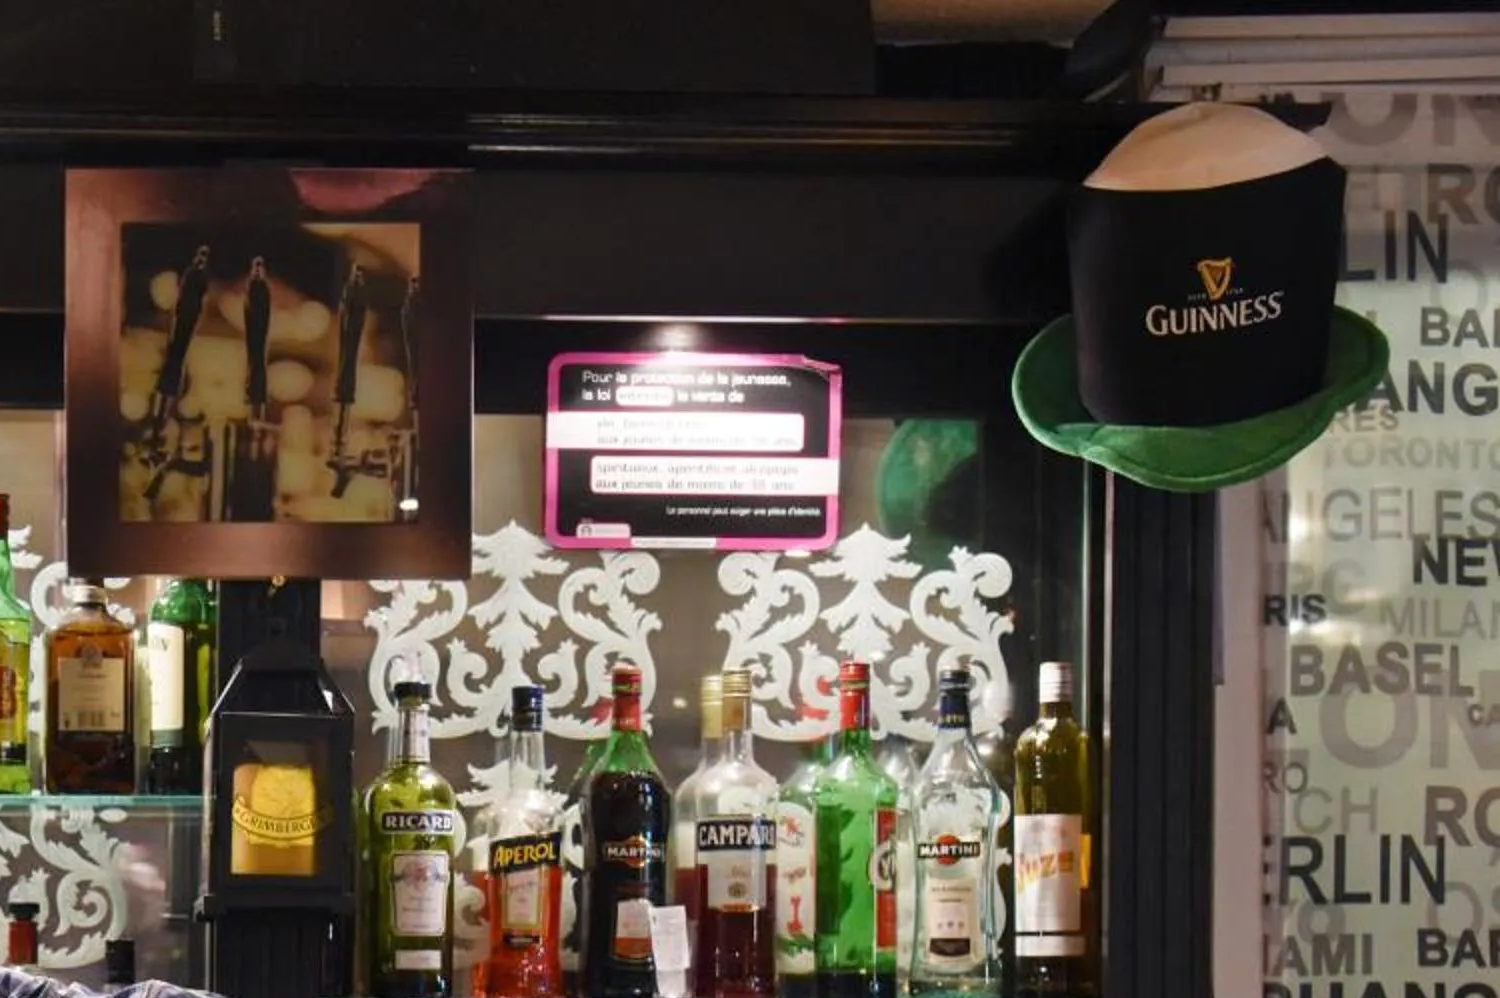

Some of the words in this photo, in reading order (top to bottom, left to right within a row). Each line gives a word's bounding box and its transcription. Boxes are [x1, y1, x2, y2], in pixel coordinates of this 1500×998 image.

[1145, 291, 1284, 336] GUINNESS
[1420, 307, 1500, 347] BA
[582, 371, 612, 384] Pour
[1412, 534, 1500, 586] NE
[1290, 641, 1474, 697] BASEL
[386, 815, 452, 829] RICARD
[700, 824, 775, 847] CAMPARI
[494, 842, 556, 866] APEROL
[920, 843, 978, 857] MARTINI
